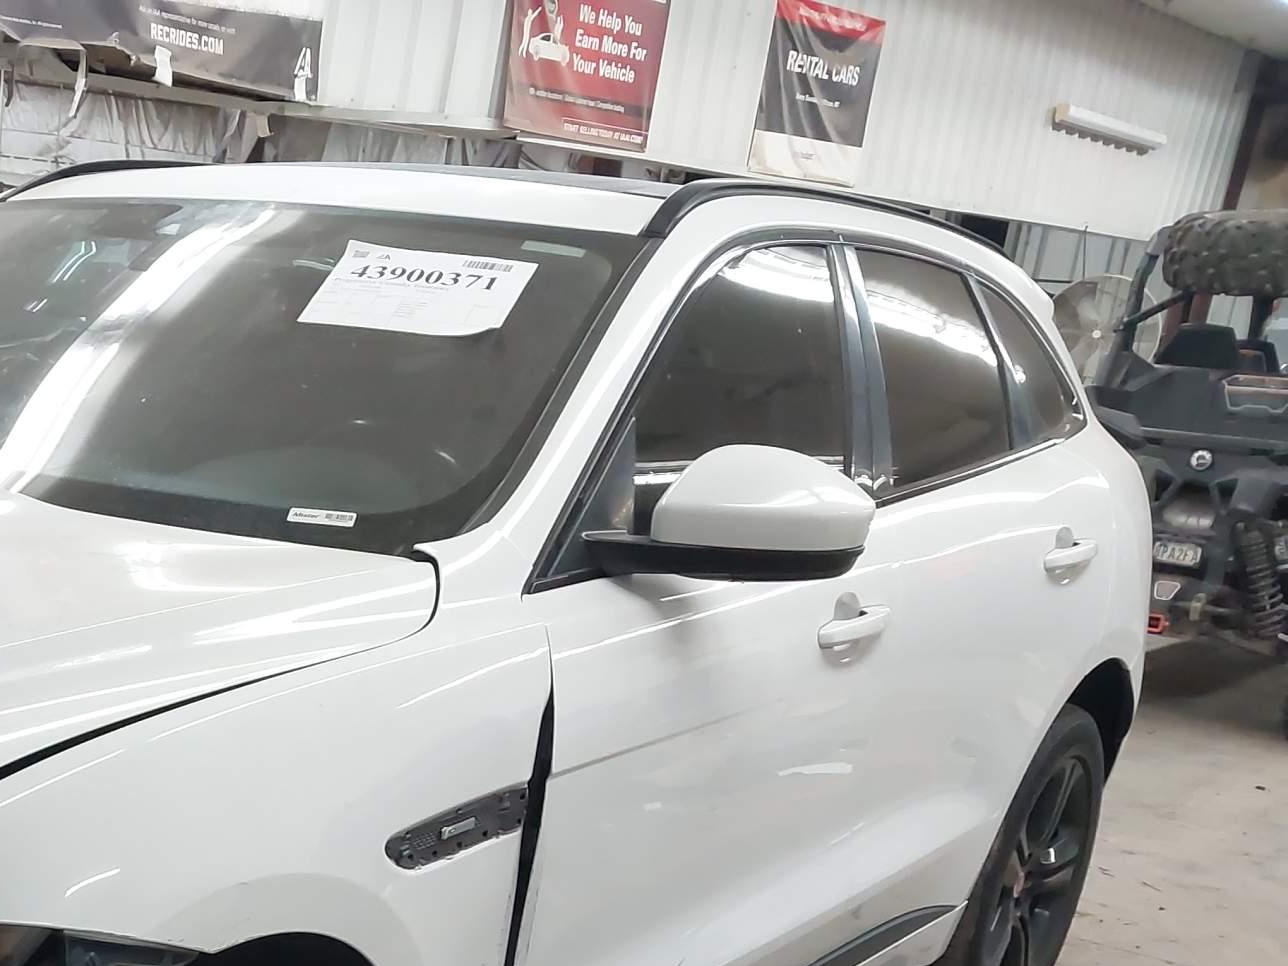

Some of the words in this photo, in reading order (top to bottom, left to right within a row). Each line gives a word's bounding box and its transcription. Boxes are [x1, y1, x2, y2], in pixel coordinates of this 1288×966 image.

[578, 3, 596, 25] We
[597, 8, 622, 35] Help
[623, 14, 643, 37] You
[150, 22, 224, 56] RECRIDES.COM
[575, 28, 600, 51] Earn
[601, 34, 629, 58] More
[629, 41, 648, 63] For
[572, 52, 597, 75] Your
[598, 58, 636, 84] Vehicle
[786, 50, 830, 81] RENTAL
[831, 63, 861, 87] CARS
[350, 263, 499, 292] 43900371
